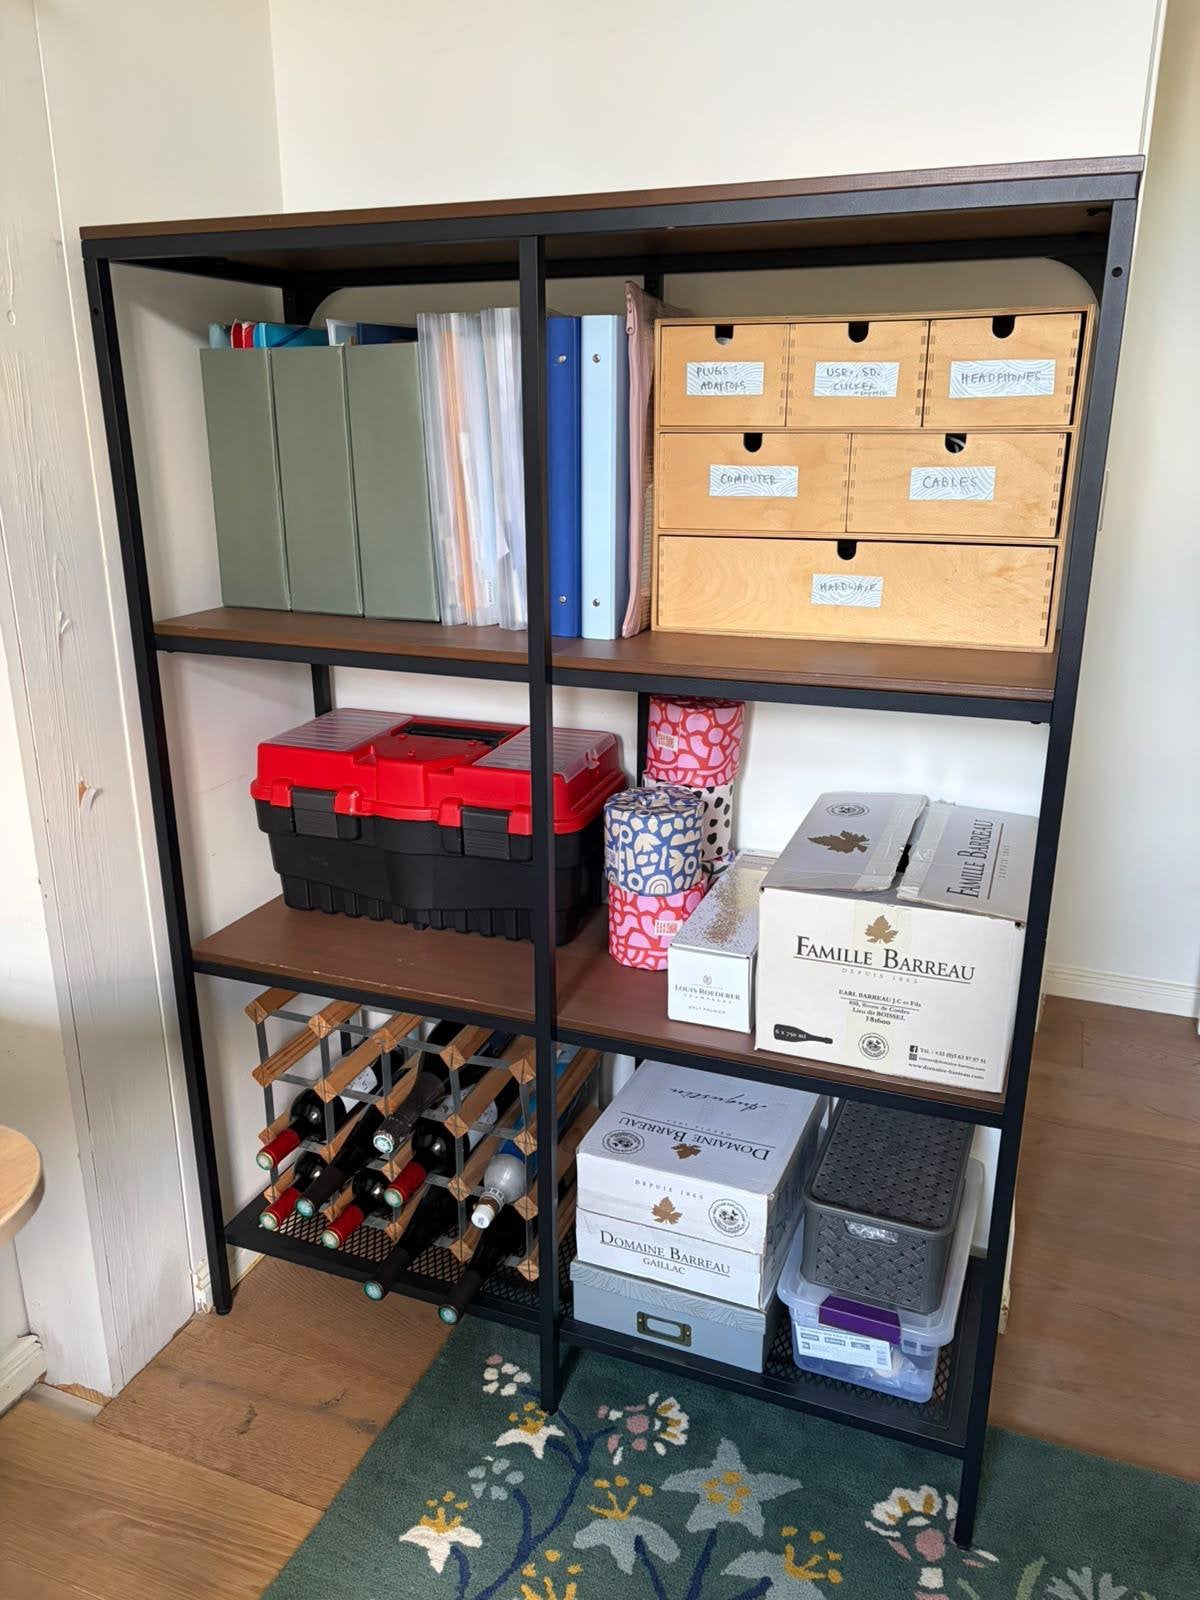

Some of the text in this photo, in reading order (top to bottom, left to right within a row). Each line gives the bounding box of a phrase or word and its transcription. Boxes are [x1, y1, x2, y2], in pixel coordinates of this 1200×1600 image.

[961, 370, 1041, 384] HEADPHONES
[720, 473, 777, 485] COMPUTER
[922, 475, 977, 489] CABLES
[819, 582, 877, 593] HARDWARE
[946, 819, 994, 898] FAMILLE BARREAU
[796, 936, 976, 981] FAMILLE BARREAU
[675, 984, 698, 993] LOUIS
[699, 988, 741, 1001] ROEDERER
[838, 988, 857, 997] EARL
[858, 992, 892, 1003] BARREAU
[876, 1011, 906, 1021] BOISSEL
[668, 1087, 768, 1113] Augustin
[617, 1116, 688, 1143] BARREAU
[691, 1134, 771, 1161] DOMAINE
[599, 1229, 731, 1275] DOMAINE BARREAU
[642, 1258, 686, 1276] GAILLAC
